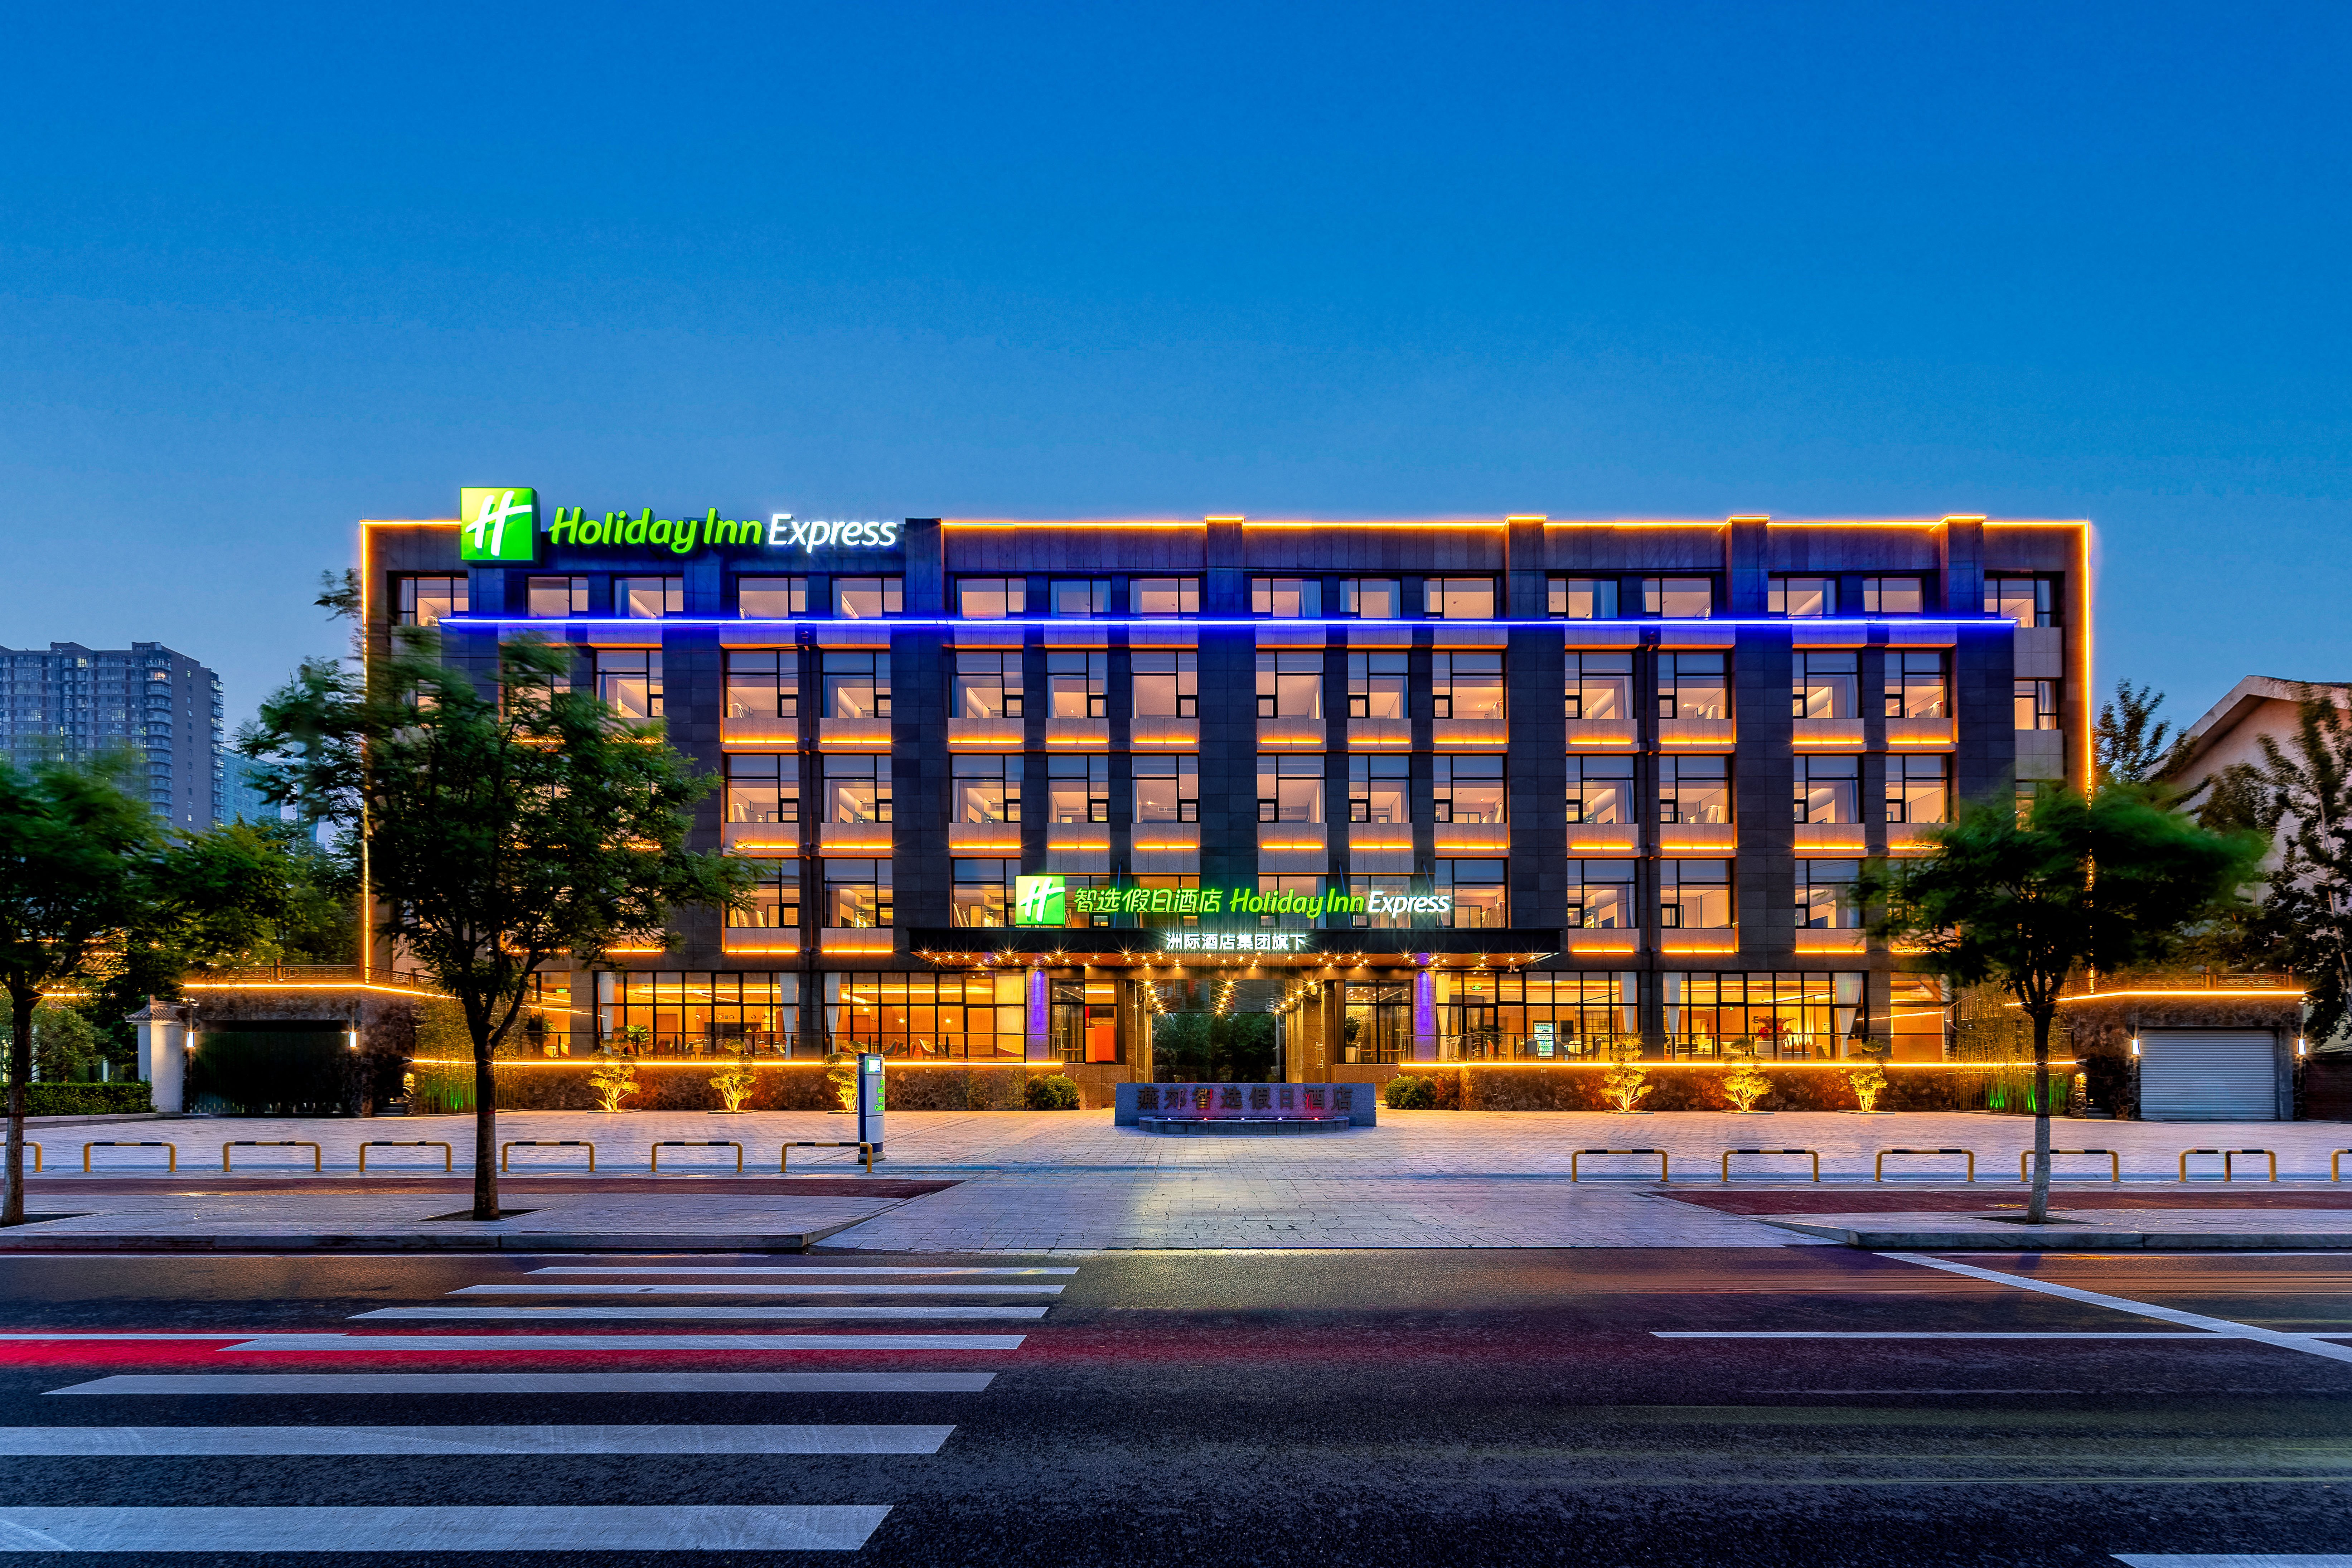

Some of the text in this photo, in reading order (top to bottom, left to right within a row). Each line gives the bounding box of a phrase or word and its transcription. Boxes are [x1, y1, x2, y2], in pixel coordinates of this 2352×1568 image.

[548, 507, 698, 553] Holiday
[703, 507, 762, 544] Inn
[768, 514, 897, 553] Express
[1074, 887, 1450, 919] 智选假日酒店 Holiday Inn Express
[1166, 933, 1306, 950] 洲际酒店集团旗下
[1137, 1086, 1352, 1110] 燕郊智选假日酒店
